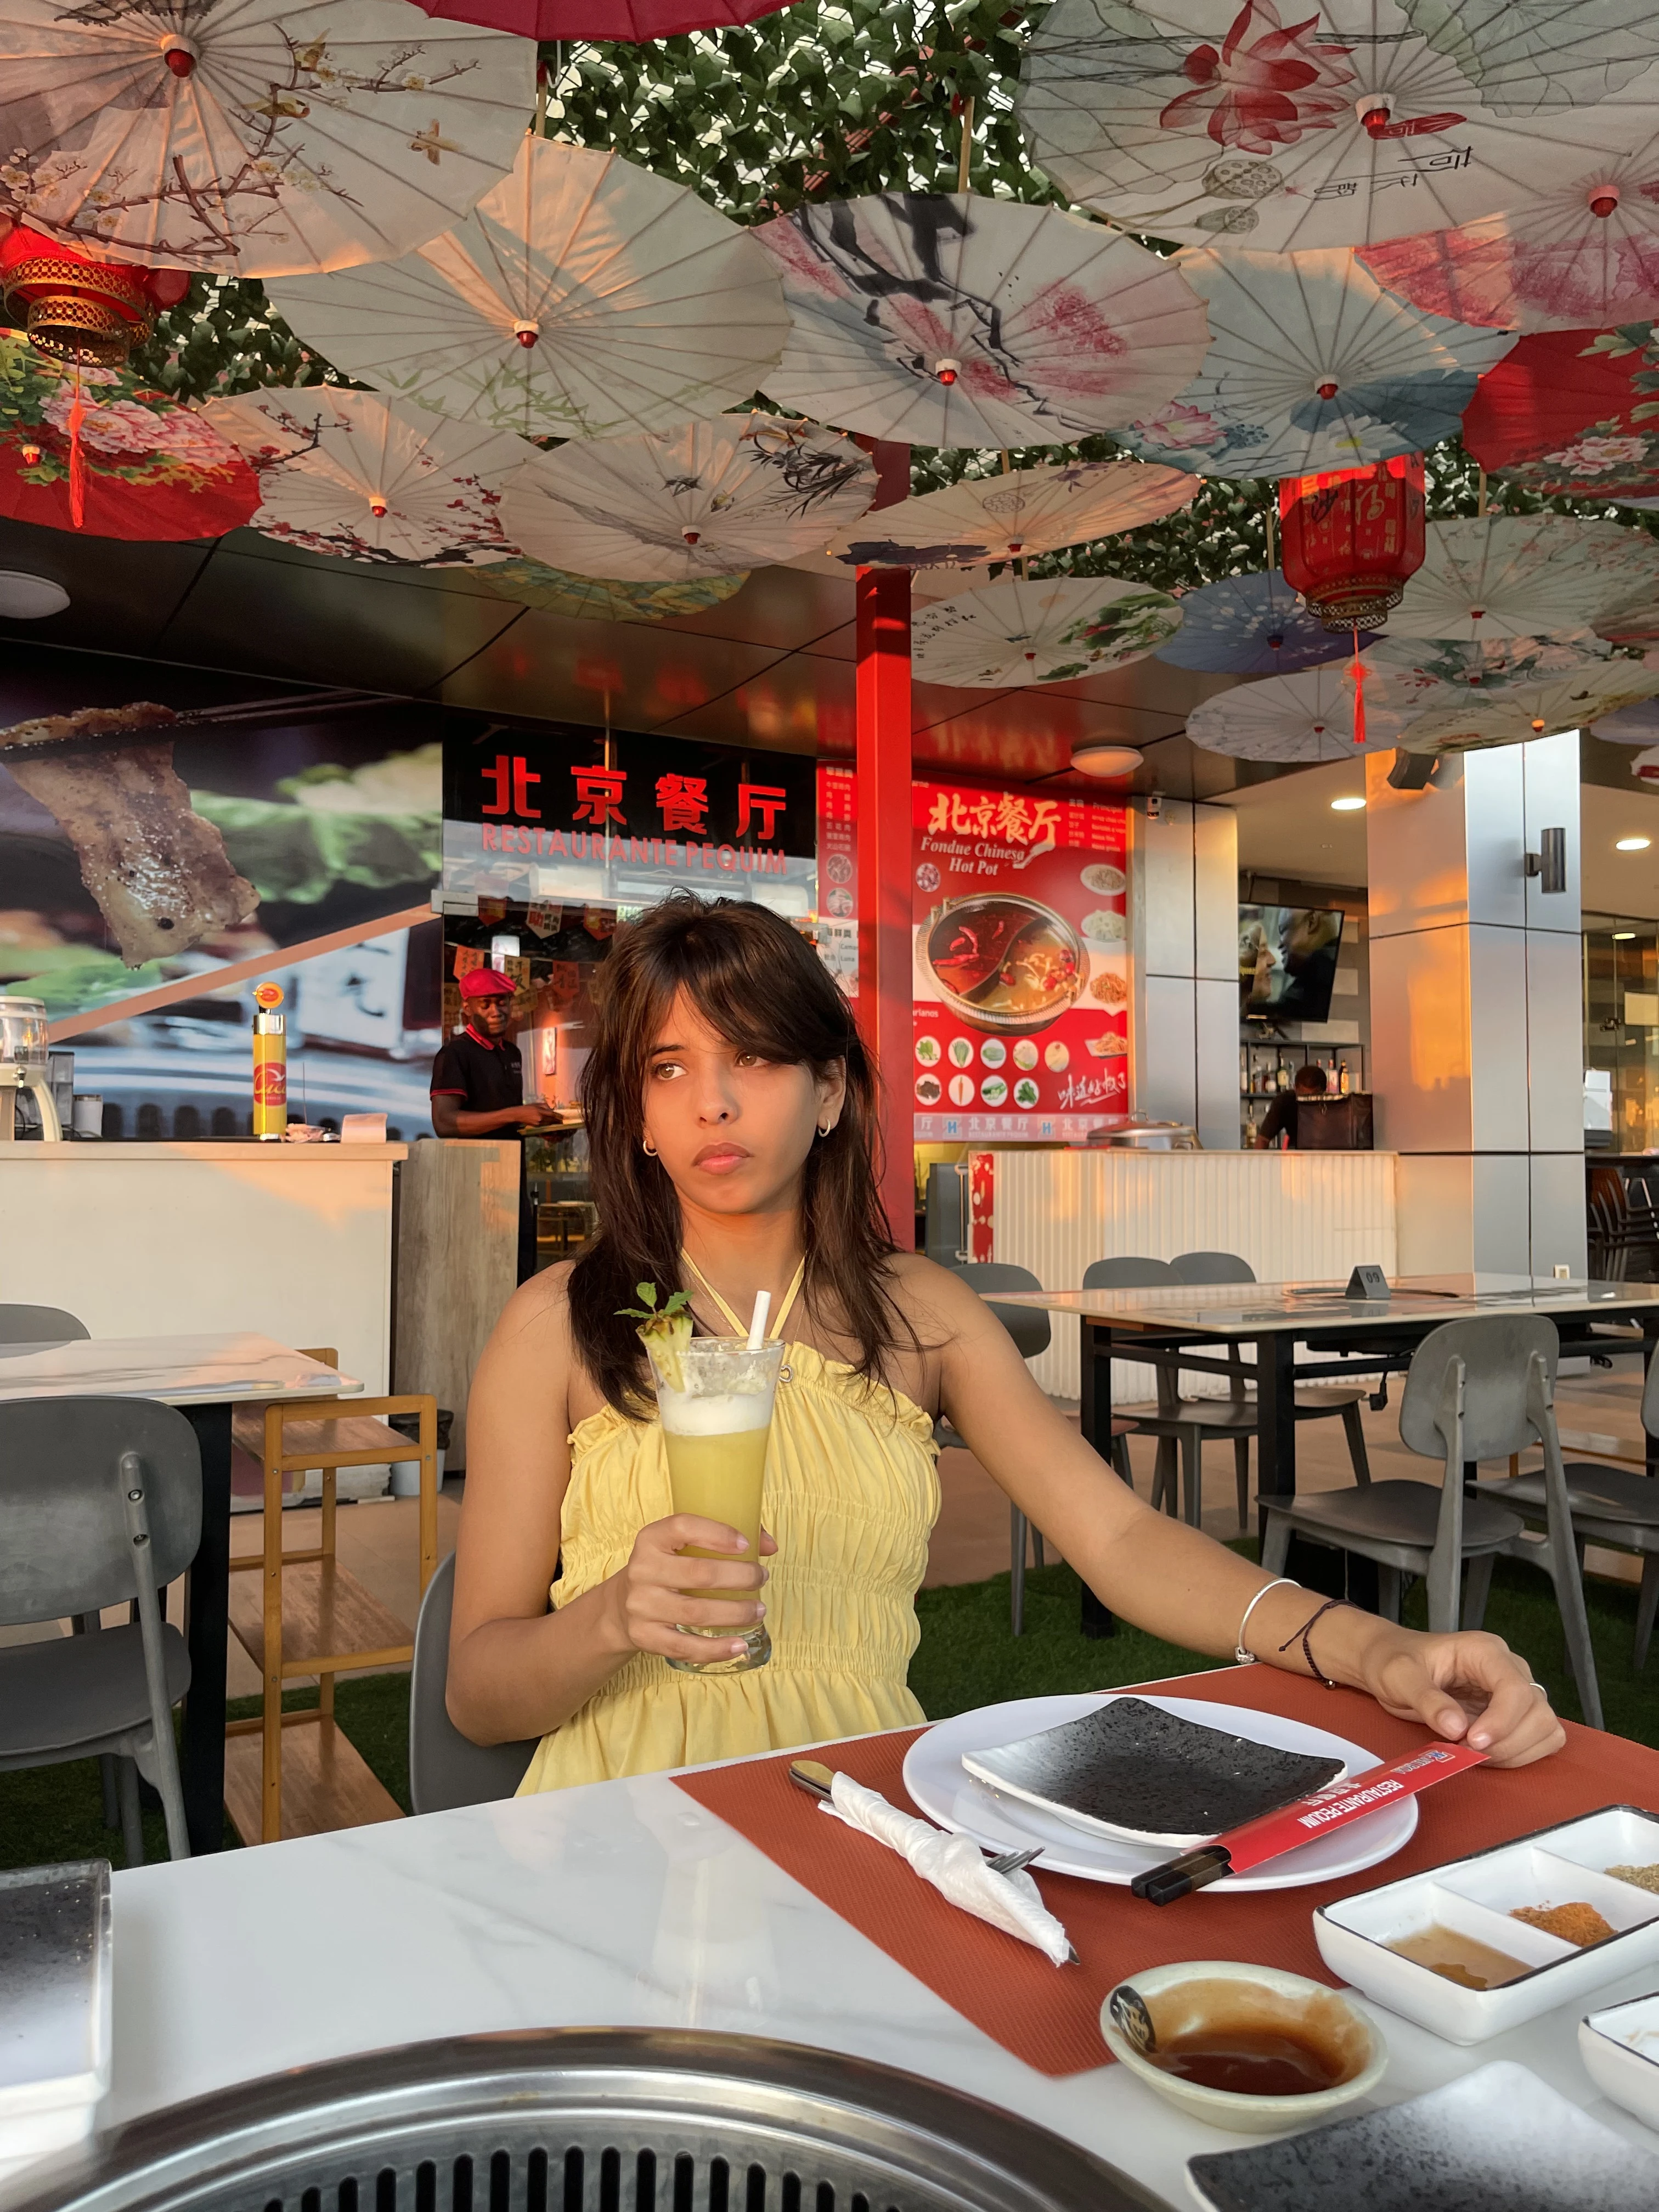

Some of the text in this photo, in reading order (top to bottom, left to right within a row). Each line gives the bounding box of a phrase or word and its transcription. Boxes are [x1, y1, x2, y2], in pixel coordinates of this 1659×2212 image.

[482, 755, 786, 840] 北京餐厅
[482, 822, 787, 876] RESTAURANTE PEQUIM
[921, 837, 1025, 862] Fondue Chinesa
[928, 791, 1062, 869] 北京餐厅
[949, 857, 998, 876] Hot Pot
[1365, 1272, 1380, 1283] 09
[1297, 1779, 1404, 1829] RESTAURANTE PEQUIM
